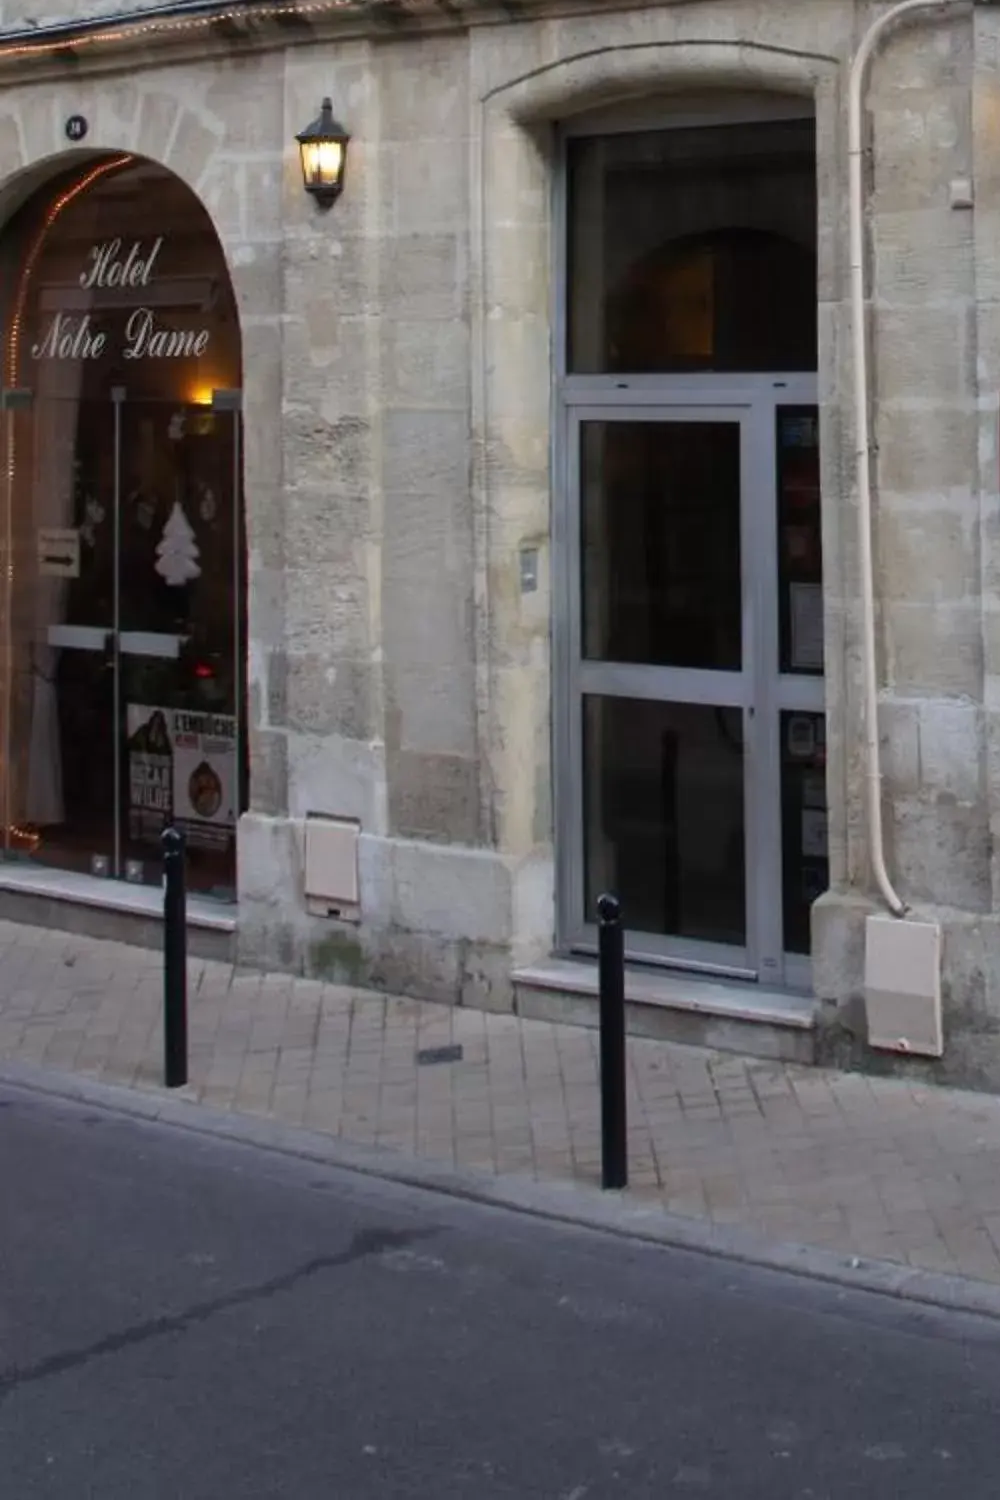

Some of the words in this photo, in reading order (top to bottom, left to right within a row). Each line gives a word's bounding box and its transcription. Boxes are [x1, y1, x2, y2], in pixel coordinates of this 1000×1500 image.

[79, 236, 164, 290] Hotel
[31, 311, 106, 360] Notre
[122, 307, 209, 359] Dame
